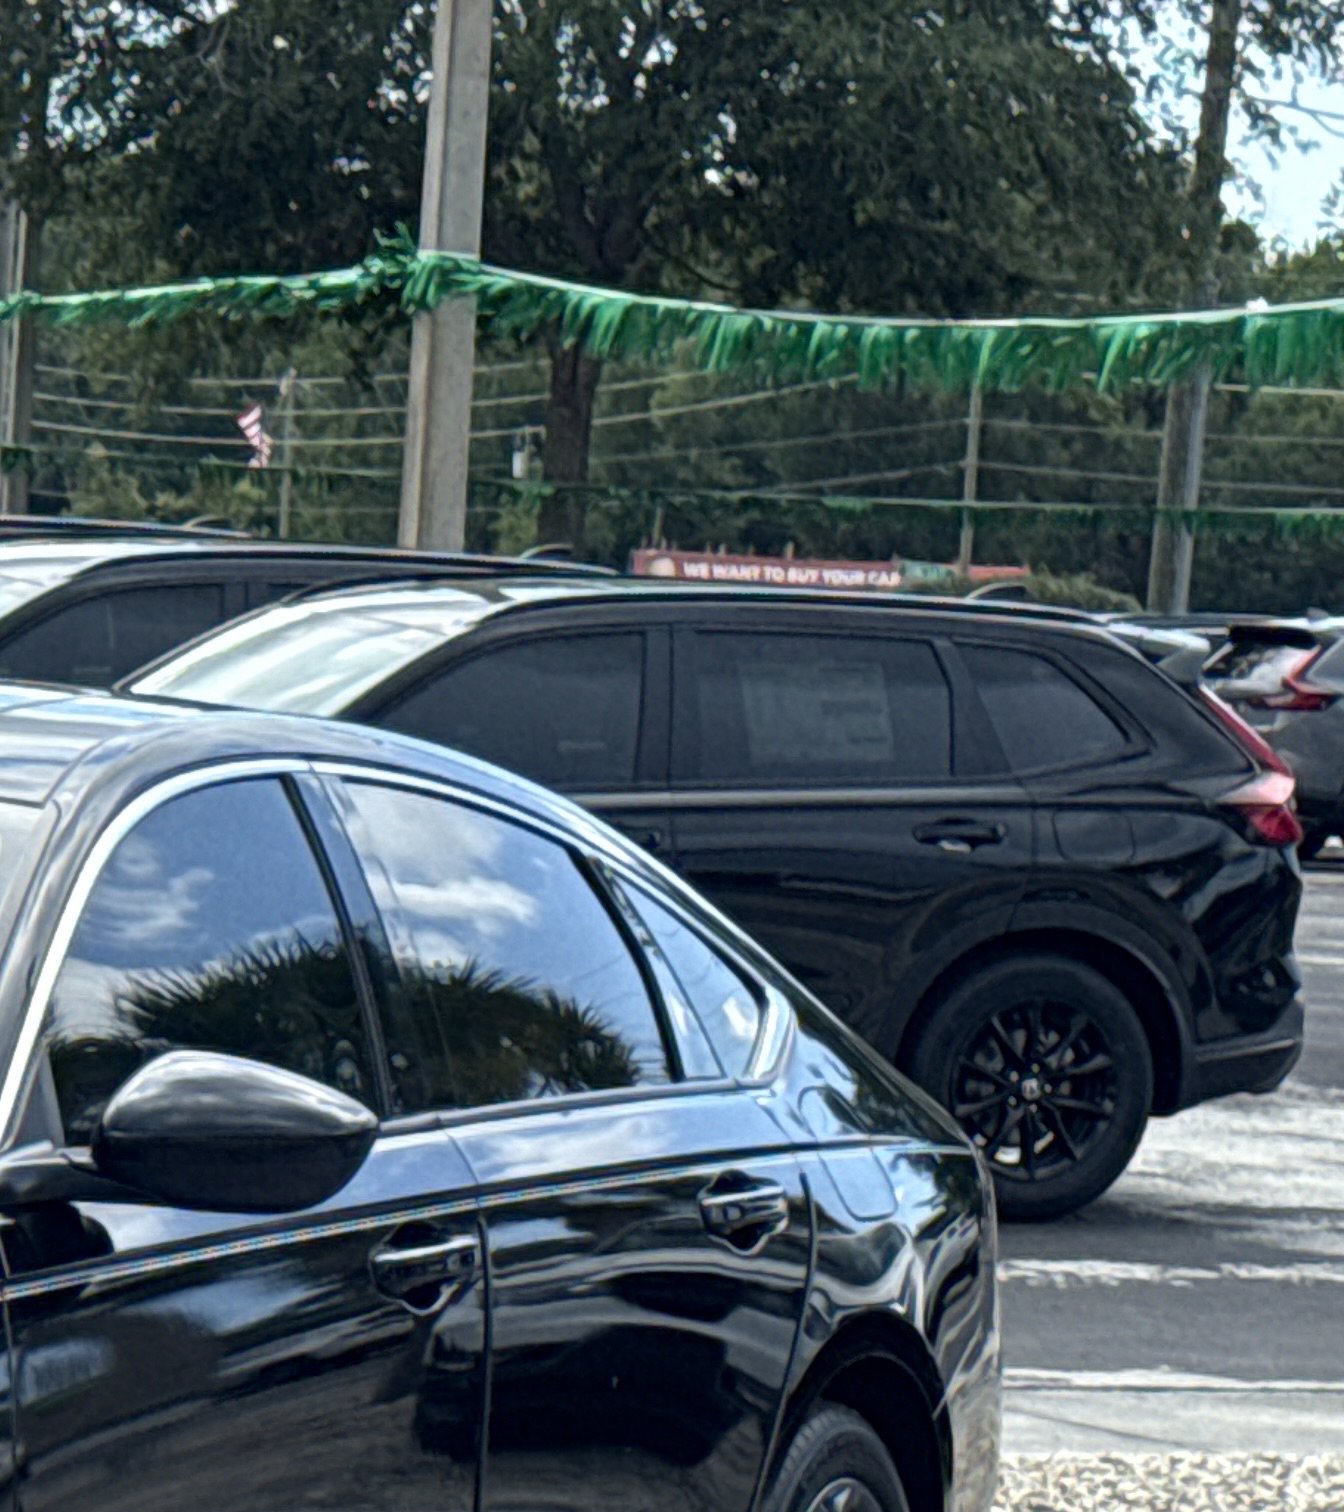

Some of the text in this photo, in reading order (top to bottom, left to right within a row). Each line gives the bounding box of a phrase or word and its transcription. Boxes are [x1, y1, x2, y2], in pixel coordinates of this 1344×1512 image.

[683, 562, 709, 579] WE
[712, 563, 761, 582] WANT
[763, 566, 785, 583] TO
[787, 567, 819, 584] BUY
[822, 568, 865, 586] YOUR
